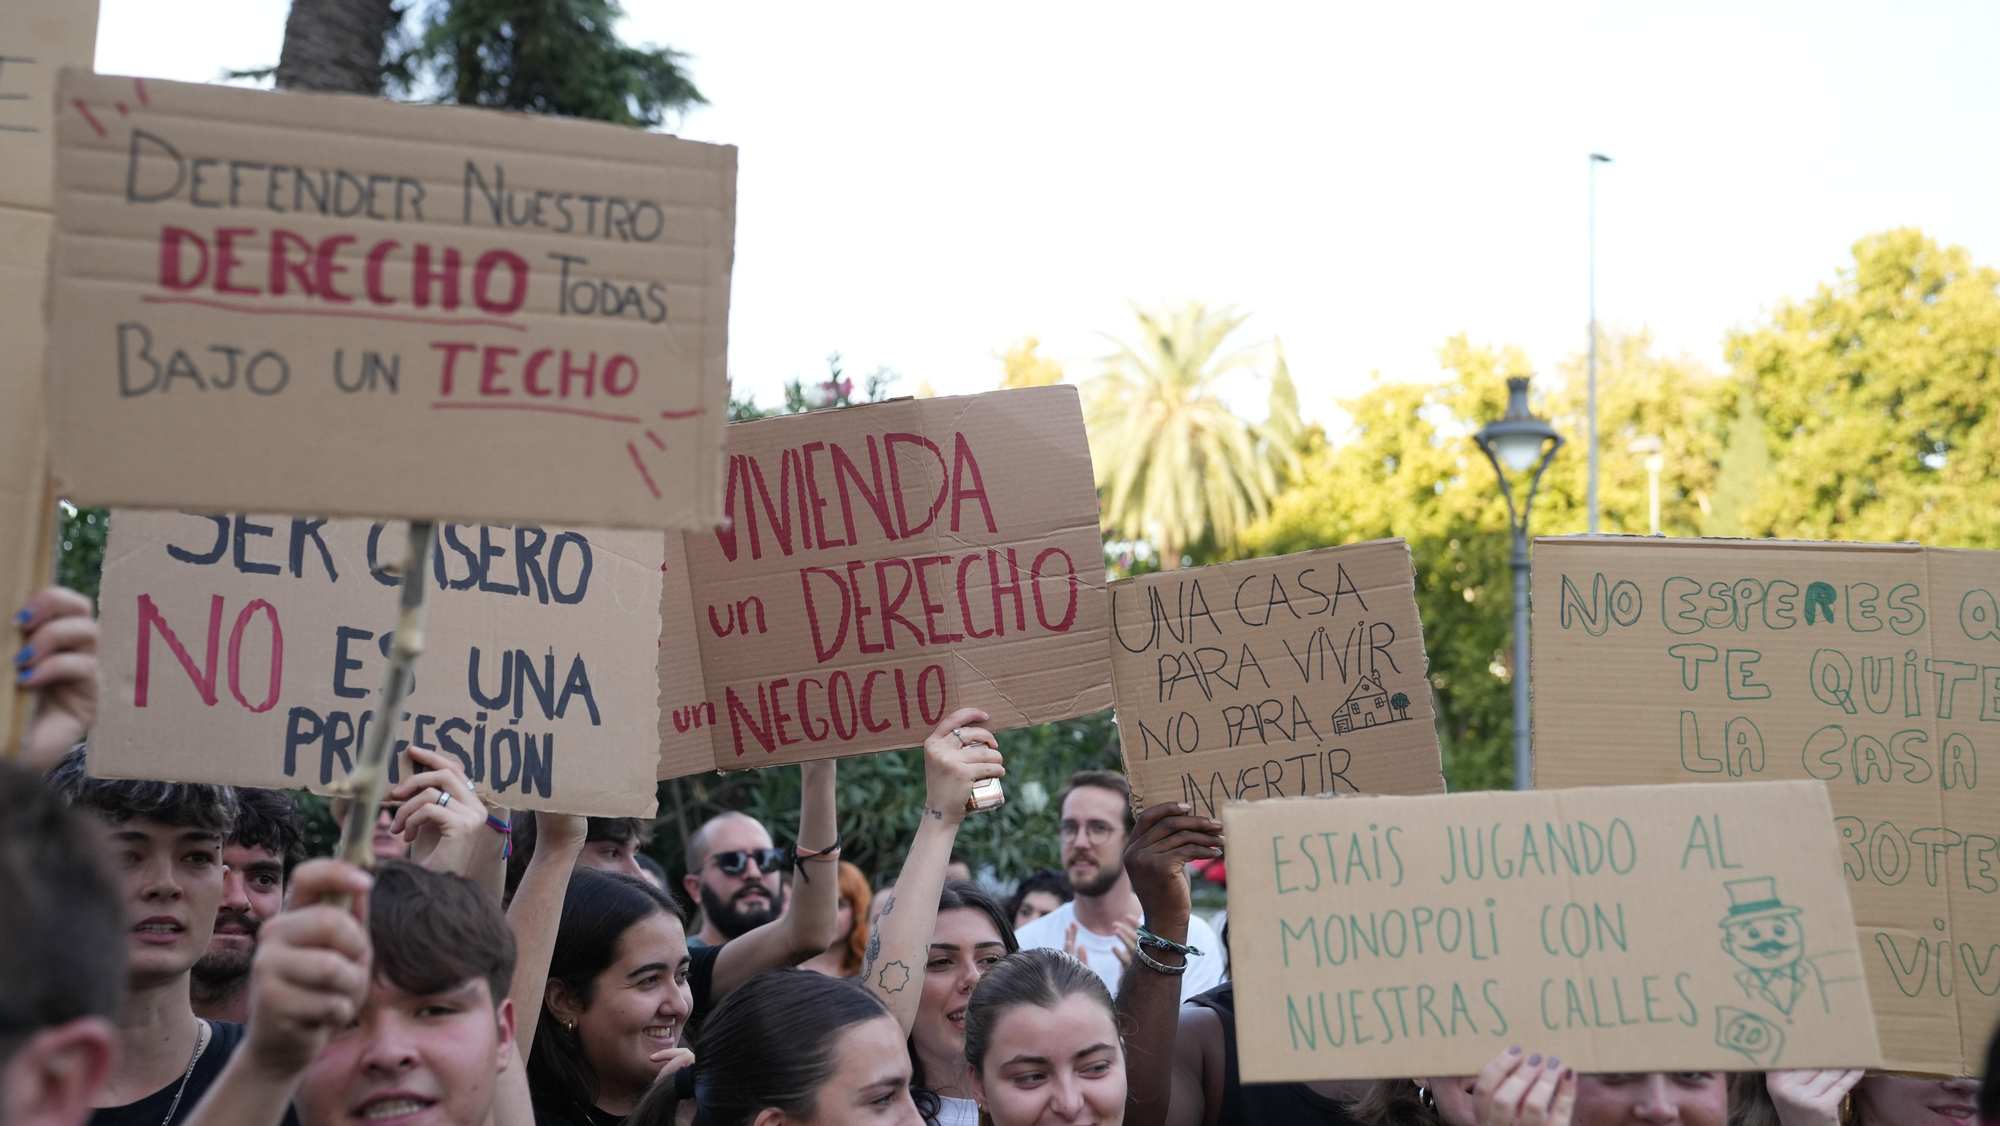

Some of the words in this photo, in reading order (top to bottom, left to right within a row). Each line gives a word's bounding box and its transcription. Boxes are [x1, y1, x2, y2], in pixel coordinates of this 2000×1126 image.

[126, 130, 426, 222] DEFENDER
[463, 160, 664, 242] NUESTRO
[159, 226, 530, 315] DERECHO
[547, 252, 668, 324] TODAS
[117, 323, 290, 398] BAJO
[333, 347, 399, 395] UN
[430, 343, 639, 399] TECHO
[166, 510, 338, 582] SER
[801, 548, 1078, 663] DERECHO
[1112, 578, 1222, 653] UNA
[1235, 563, 1369, 626] CASA
[1560, 572, 1643, 636] NO
[1662, 576, 1926, 636] ESPERES
[134, 593, 283, 713] NO
[469, 645, 601, 726] UNA
[1158, 643, 1271, 702] PARA
[1668, 643, 1772, 700] TE
[725, 665, 946, 756] NEGOCIO
[1138, 711, 1199, 760] NO
[1222, 695, 1323, 747] PARA
[1680, 709, 1765, 777] LA
[1802, 724, 1977, 791] CASA
[1441, 817, 1637, 885] JUGANDO
[1680, 813, 1743, 871] AL
[1833, 816, 2000, 894] ROTE
[1540, 902, 1628, 958] CON
[1286, 979, 1509, 1051] NUESTRAS
[1540, 972, 1699, 1033] CALLES
